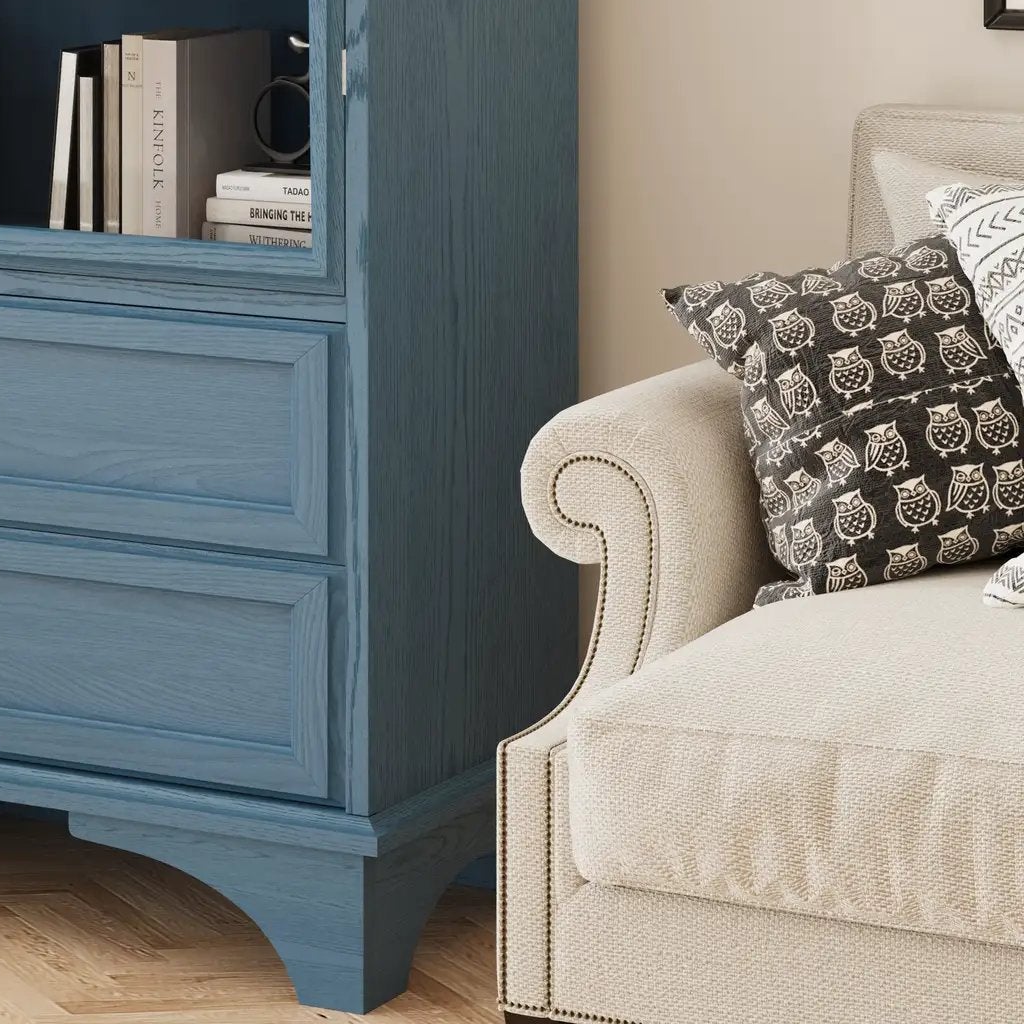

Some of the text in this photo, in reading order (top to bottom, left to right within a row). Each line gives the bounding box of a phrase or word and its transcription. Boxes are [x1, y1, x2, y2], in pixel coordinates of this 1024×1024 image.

[153, 109, 164, 189] KINFOLK
[282, 186, 310, 196] TADAO
[249, 207, 288, 221] BRINGING
[290, 210, 305, 222] THE
